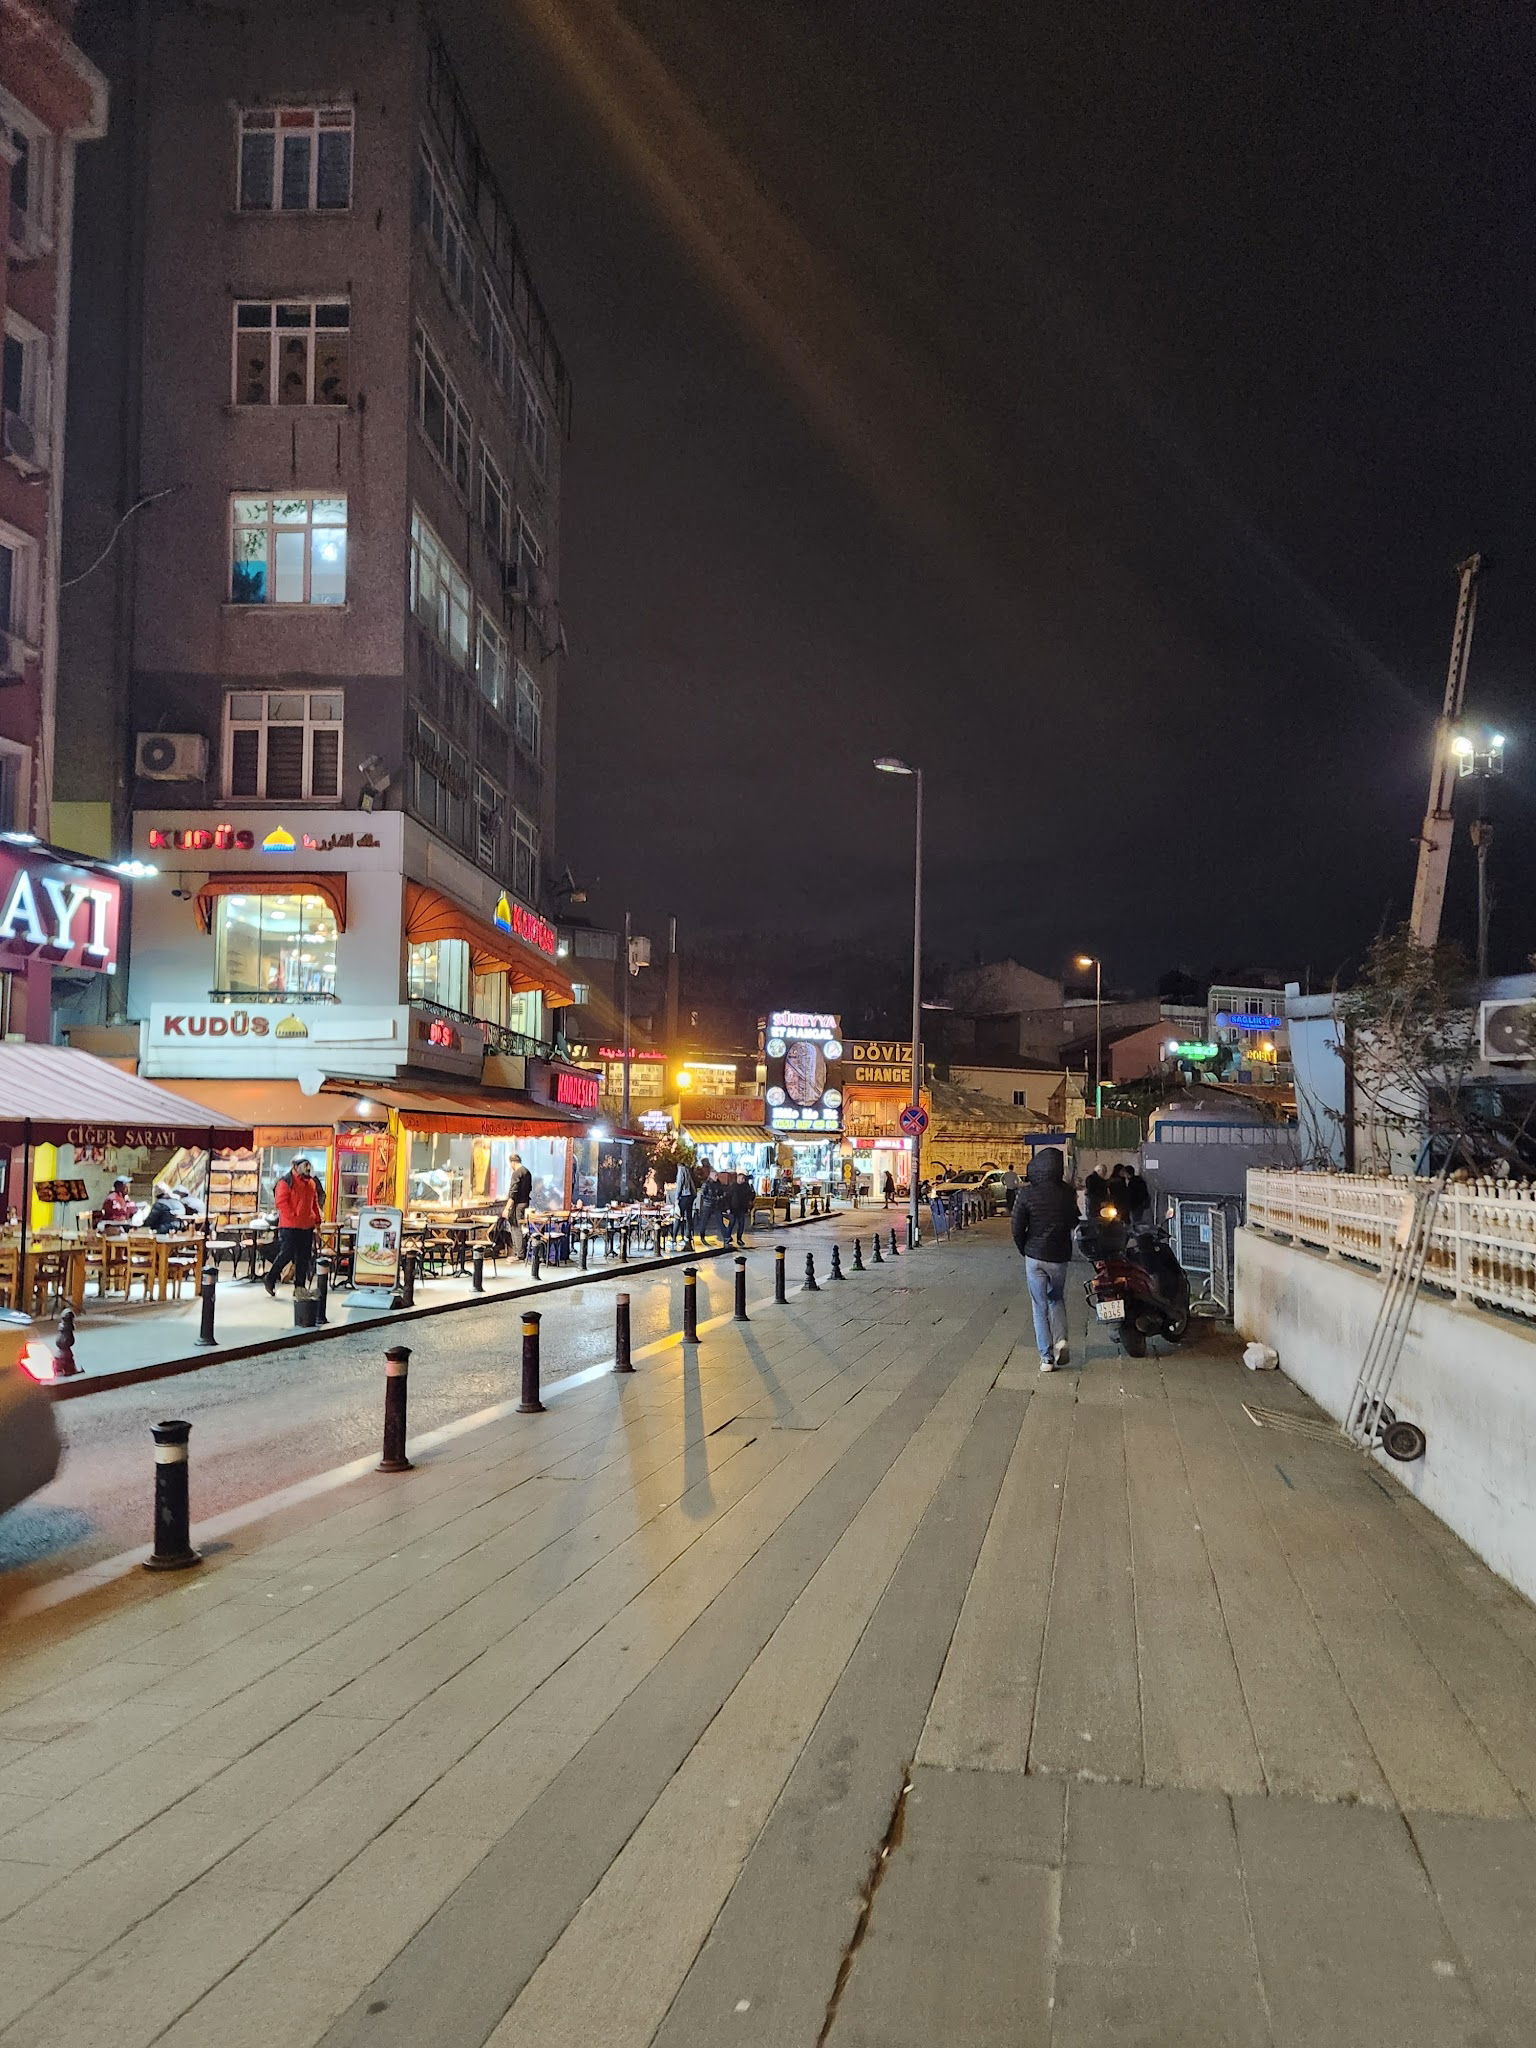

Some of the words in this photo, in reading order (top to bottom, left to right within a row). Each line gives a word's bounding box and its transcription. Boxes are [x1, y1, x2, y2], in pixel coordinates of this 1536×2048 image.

[149, 824, 254, 850] KUDÜS
[164, 1010, 270, 1036] KUDÜS
[853, 1042, 913, 1062] DÖVİZ
[855, 1067, 911, 1083] CHANGE
[705, 1110, 741, 1122] Shoping
[67, 1124, 118, 1145] CİĞER
[125, 1129, 177, 1147] SARAYI
